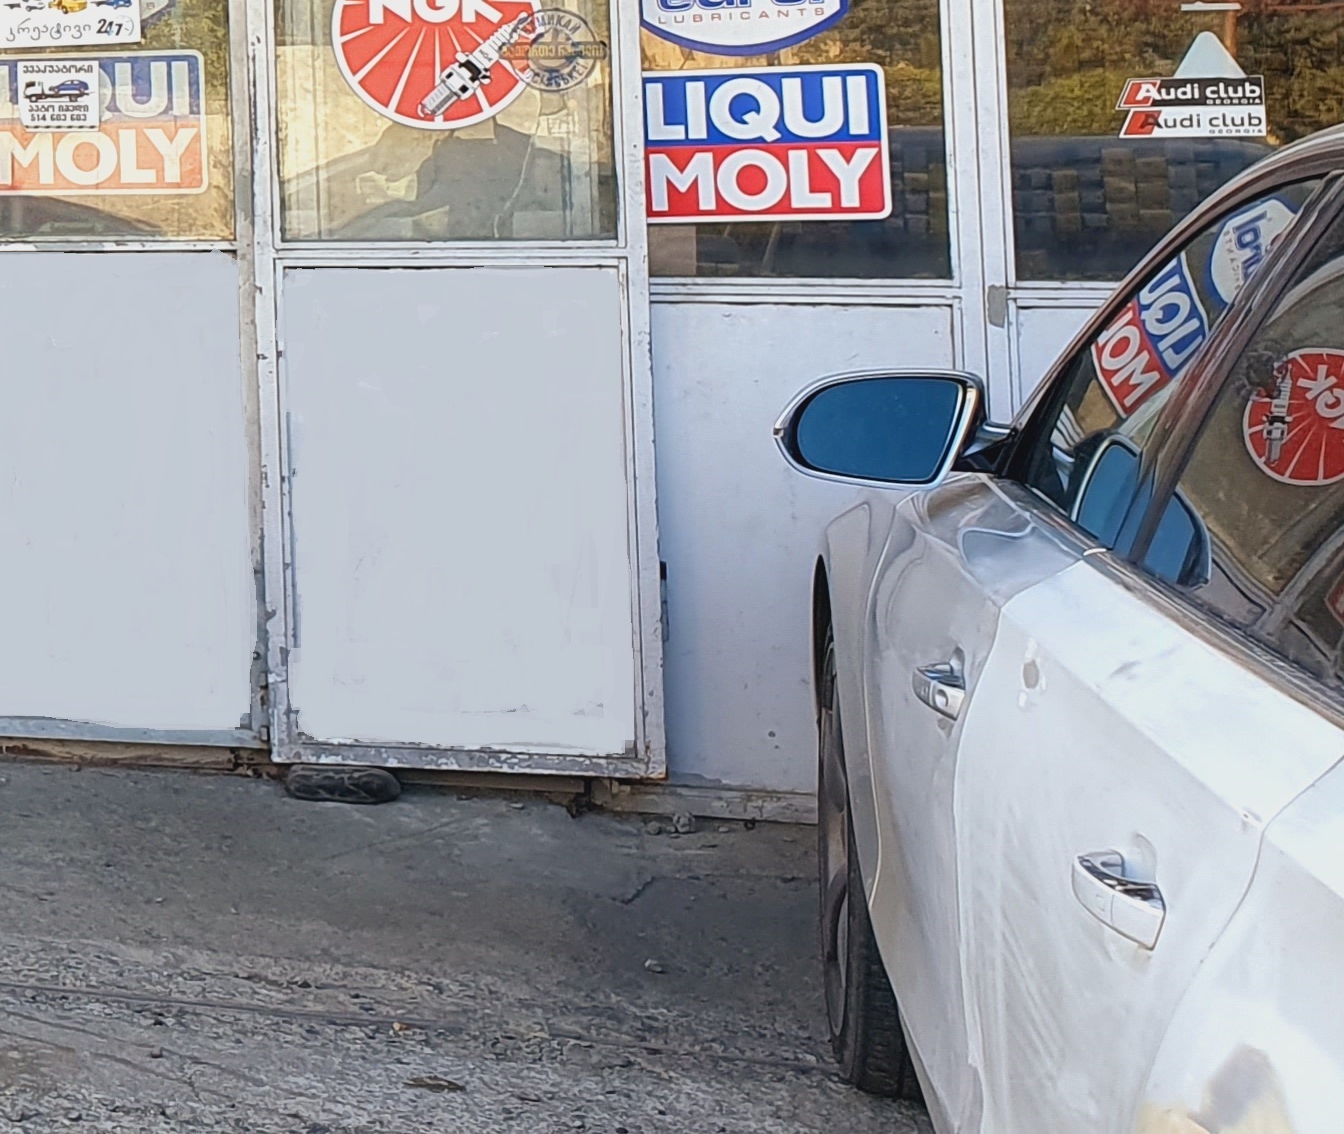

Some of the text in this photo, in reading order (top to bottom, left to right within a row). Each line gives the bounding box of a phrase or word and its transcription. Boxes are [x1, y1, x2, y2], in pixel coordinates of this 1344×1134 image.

[657, 7, 826, 25] LUBRICANTS
[1135, 81, 1261, 100] Audi club
[647, 74, 870, 143] LIQUI
[1139, 111, 1263, 130] Audi club
[650, 146, 880, 212] MOLY
